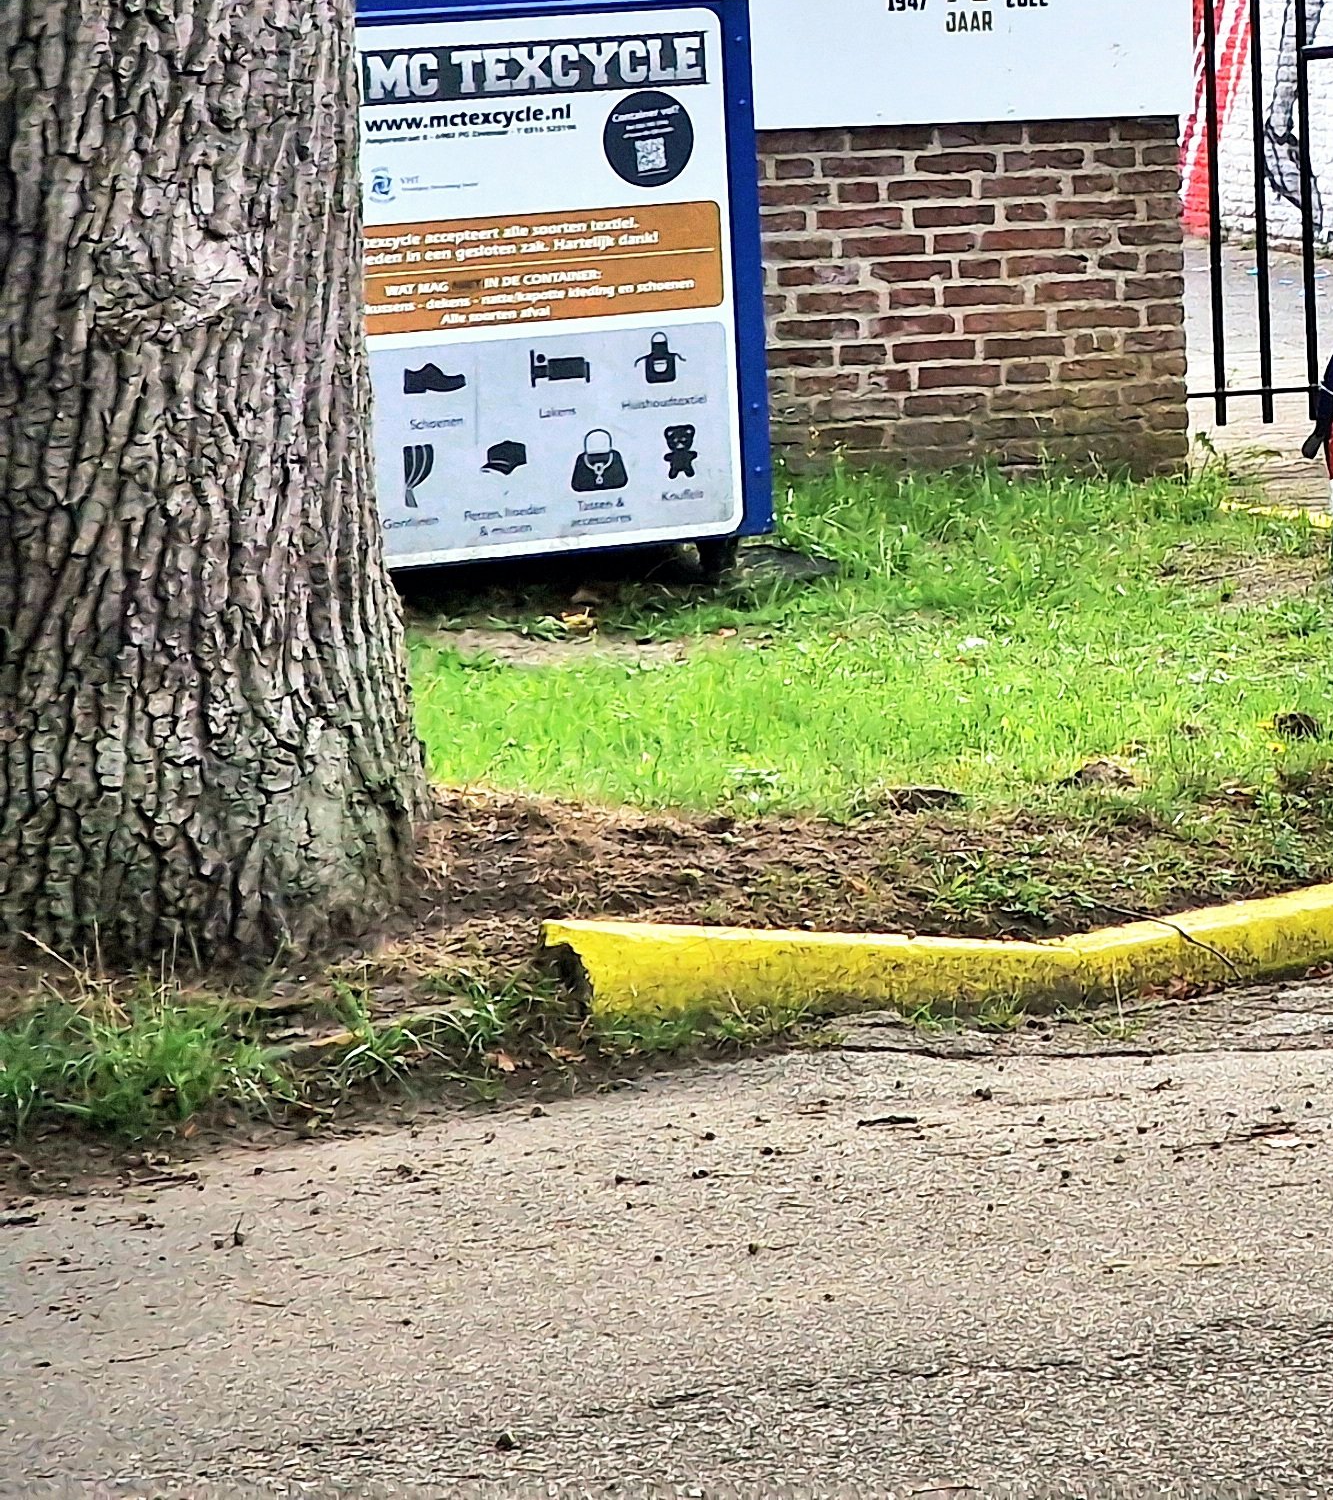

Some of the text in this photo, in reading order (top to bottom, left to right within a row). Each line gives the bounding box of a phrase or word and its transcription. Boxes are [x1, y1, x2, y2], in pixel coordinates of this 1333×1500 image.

[945, 10, 993, 33] JAAR
[368, 36, 703, 100] MC TEXCYCLE
[365, 103, 571, 132] www.mctexcycle.nl
[425, 228, 500, 246] accepteert
[502, 225, 529, 239] alle
[406, 250, 421, 263] in
[424, 249, 452, 262] een
[455, 243, 516, 262] gesloten
[553, 235, 616, 251] Hartelijk
[417, 281, 450, 295] MAG
[484, 276, 500, 289] IN
[502, 274, 521, 287] DE
[568, 285, 615, 299] kleding
[618, 283, 635, 295] en
[539, 406, 577, 419] Lakens
[410, 417, 464, 431] Schoenen
[616, 497, 625, 508] &
